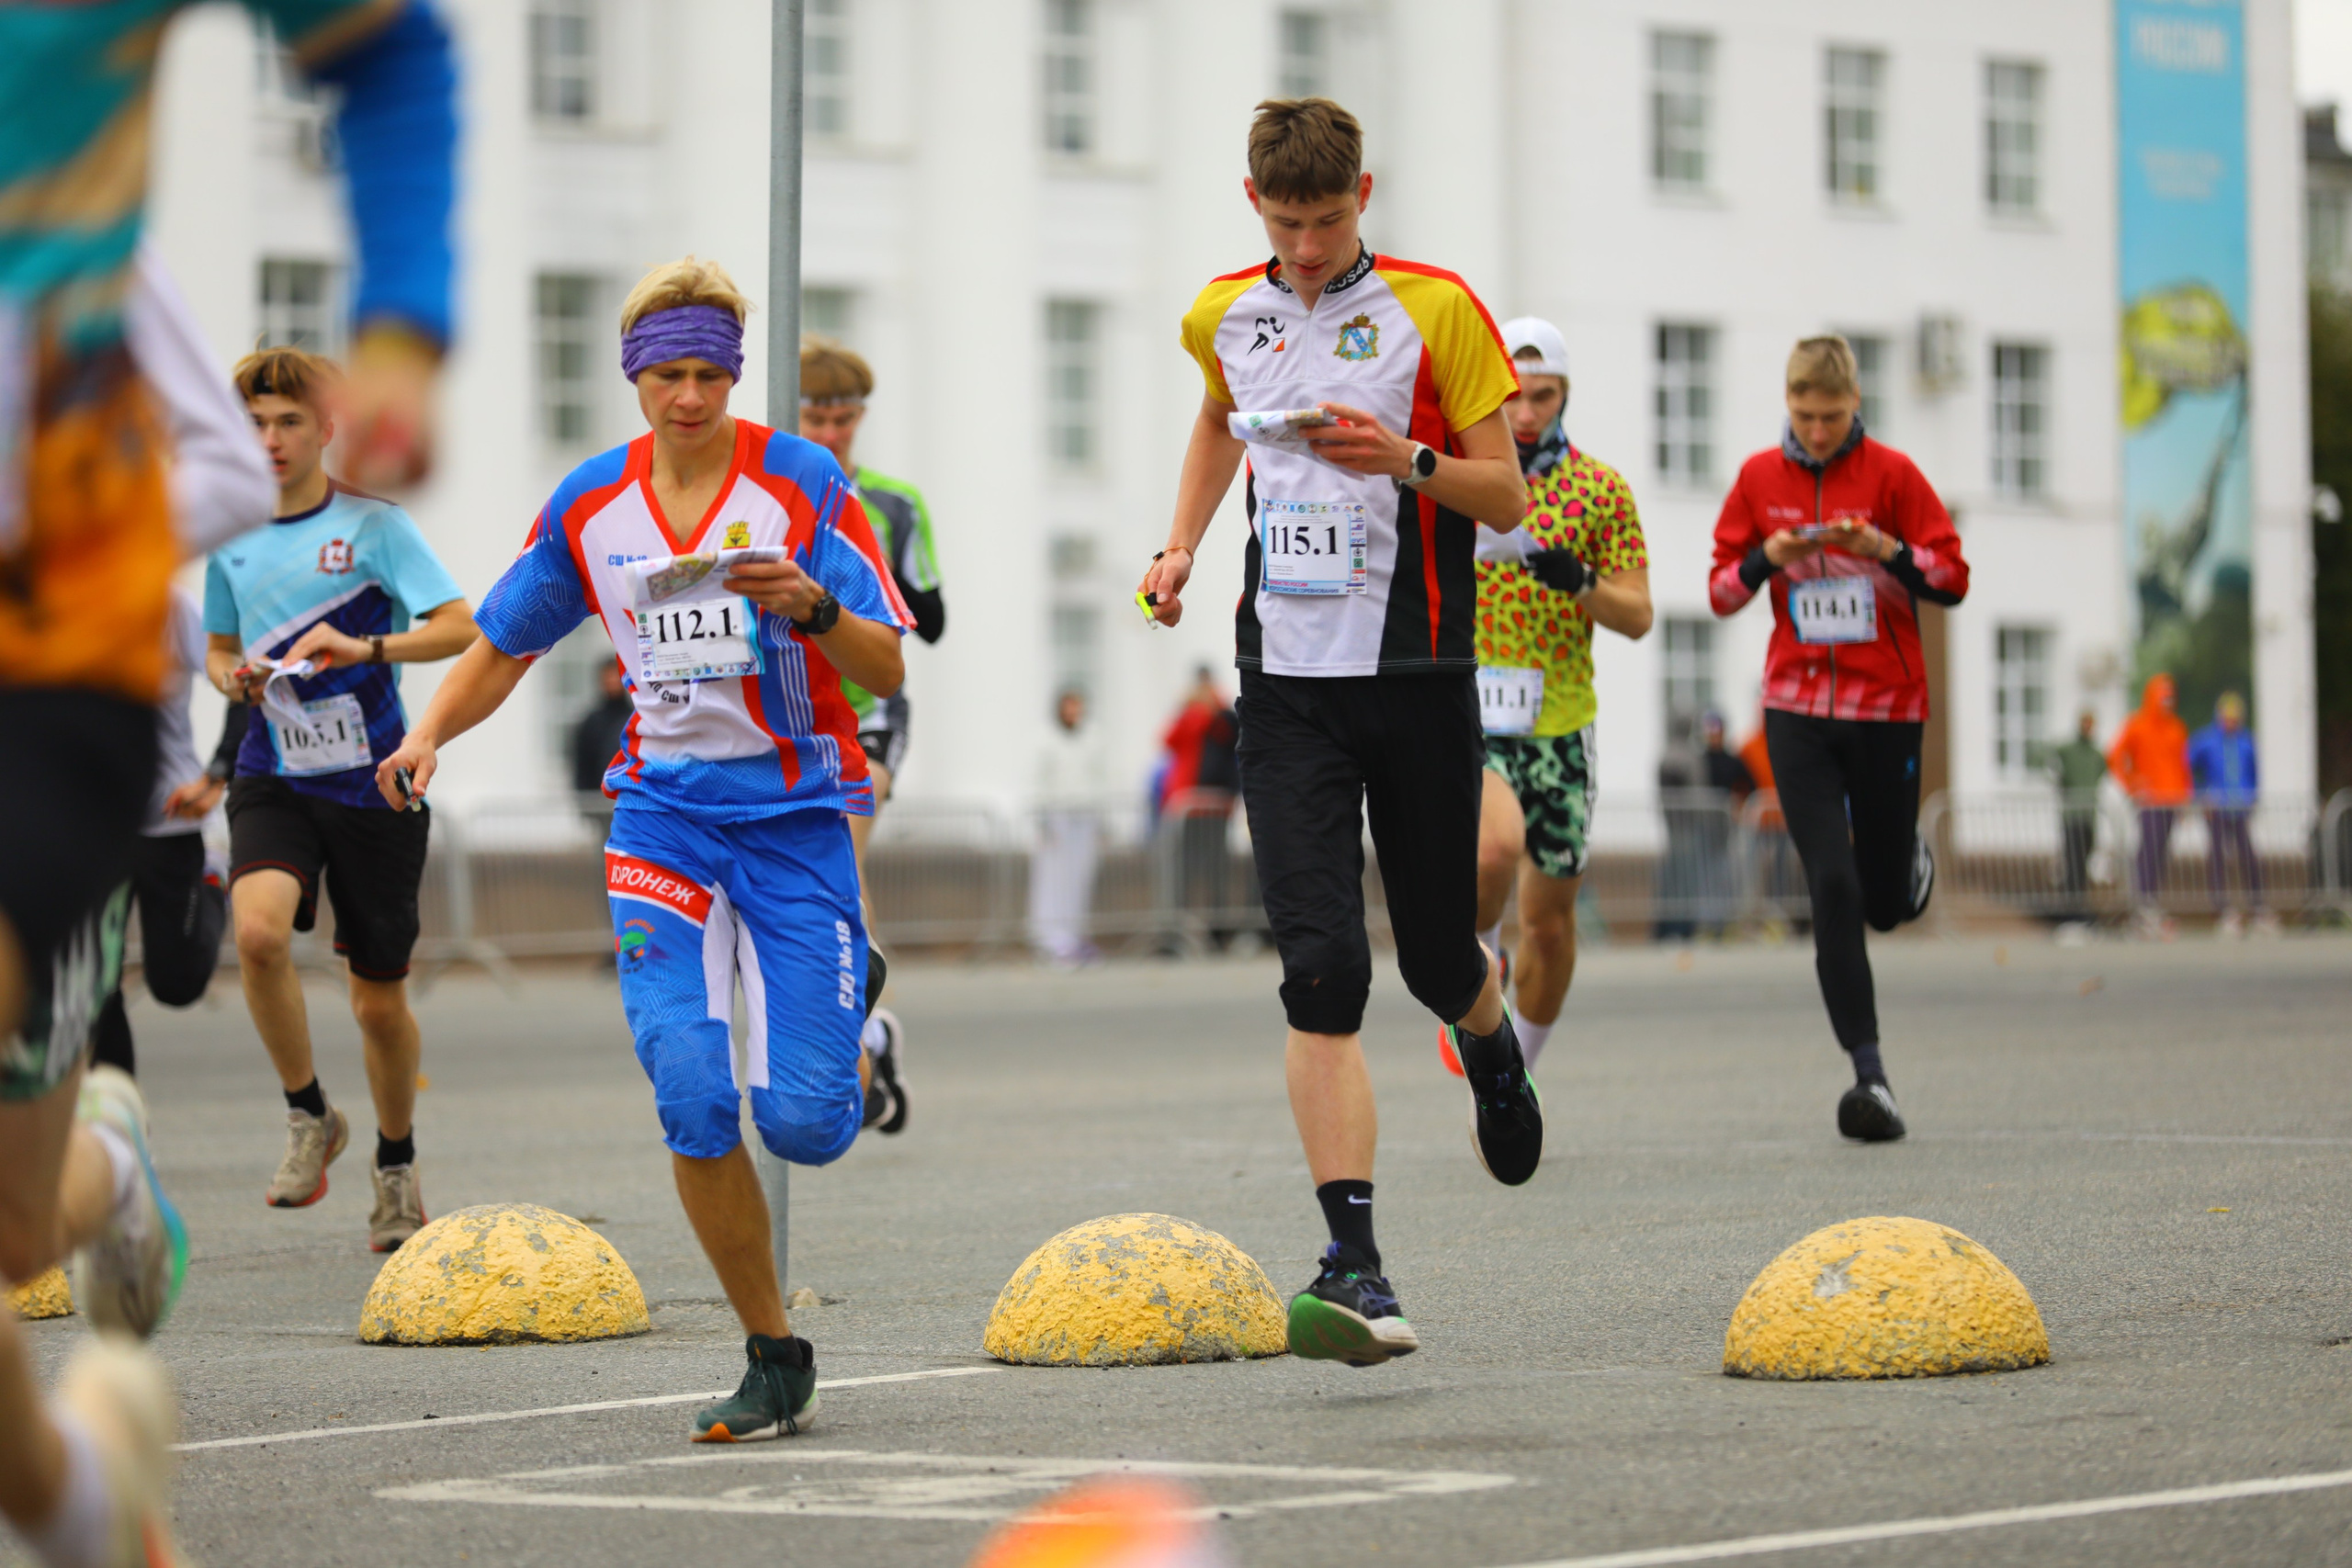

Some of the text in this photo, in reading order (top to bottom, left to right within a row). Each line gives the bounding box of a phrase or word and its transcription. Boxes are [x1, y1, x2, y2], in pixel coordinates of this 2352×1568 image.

[1269, 525, 1341, 556] 115.1
[607, 554, 624, 566] СШ
[1802, 595, 1858, 619] 114.1
[655, 606, 735, 644] 112.1
[838, 971, 856, 1010] СШ
